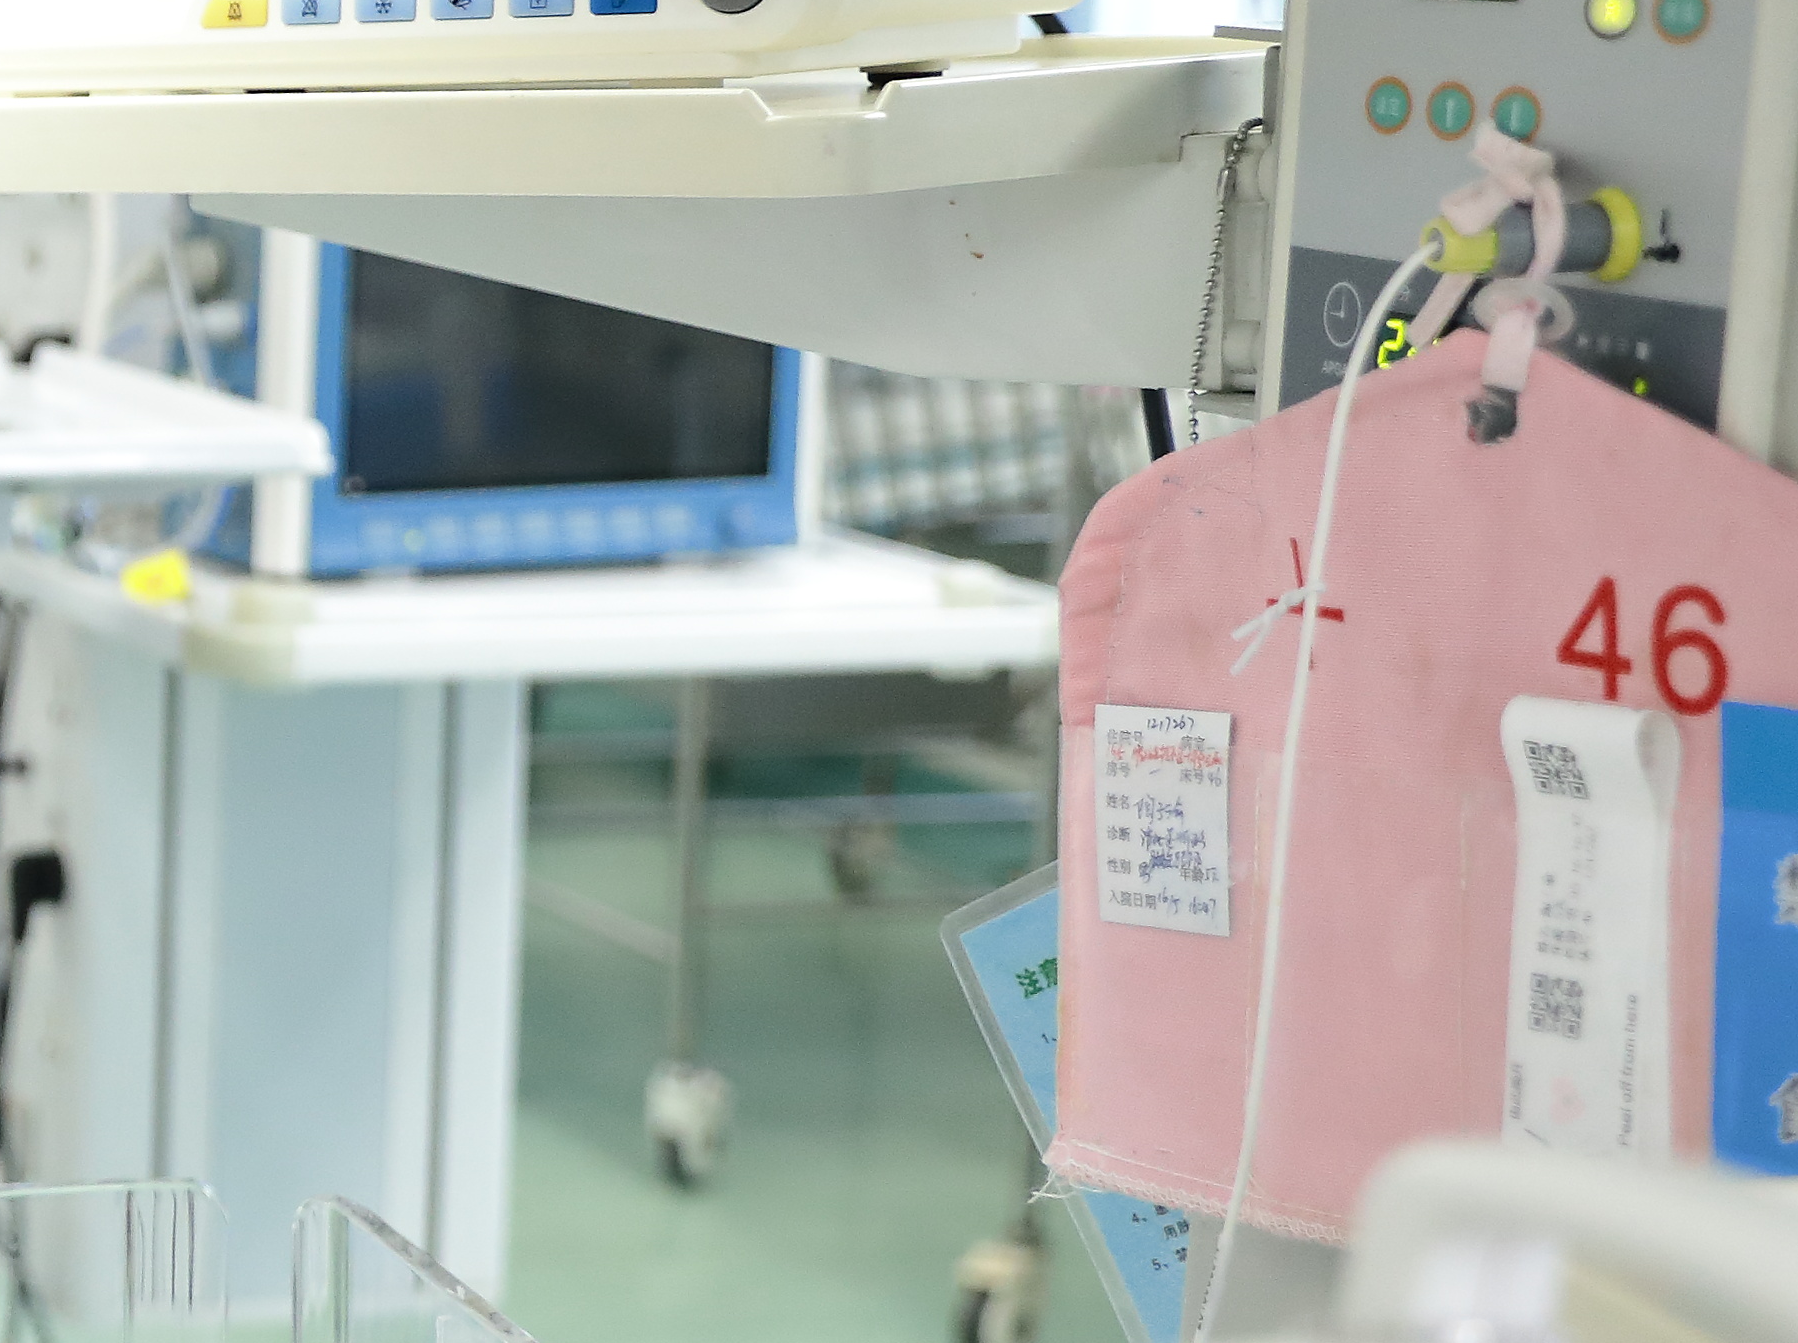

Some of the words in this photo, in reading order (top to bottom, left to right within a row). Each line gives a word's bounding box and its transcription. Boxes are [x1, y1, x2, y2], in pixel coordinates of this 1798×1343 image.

[1555, 574, 1730, 718] 46
[1105, 792, 1131, 811] 姓名
[1106, 825, 1131, 842] 诊断
[1106, 857, 1131, 875] 性别
[1179, 866, 1205, 883] 年龄
[1108, 889, 1156, 910] 入院日期
